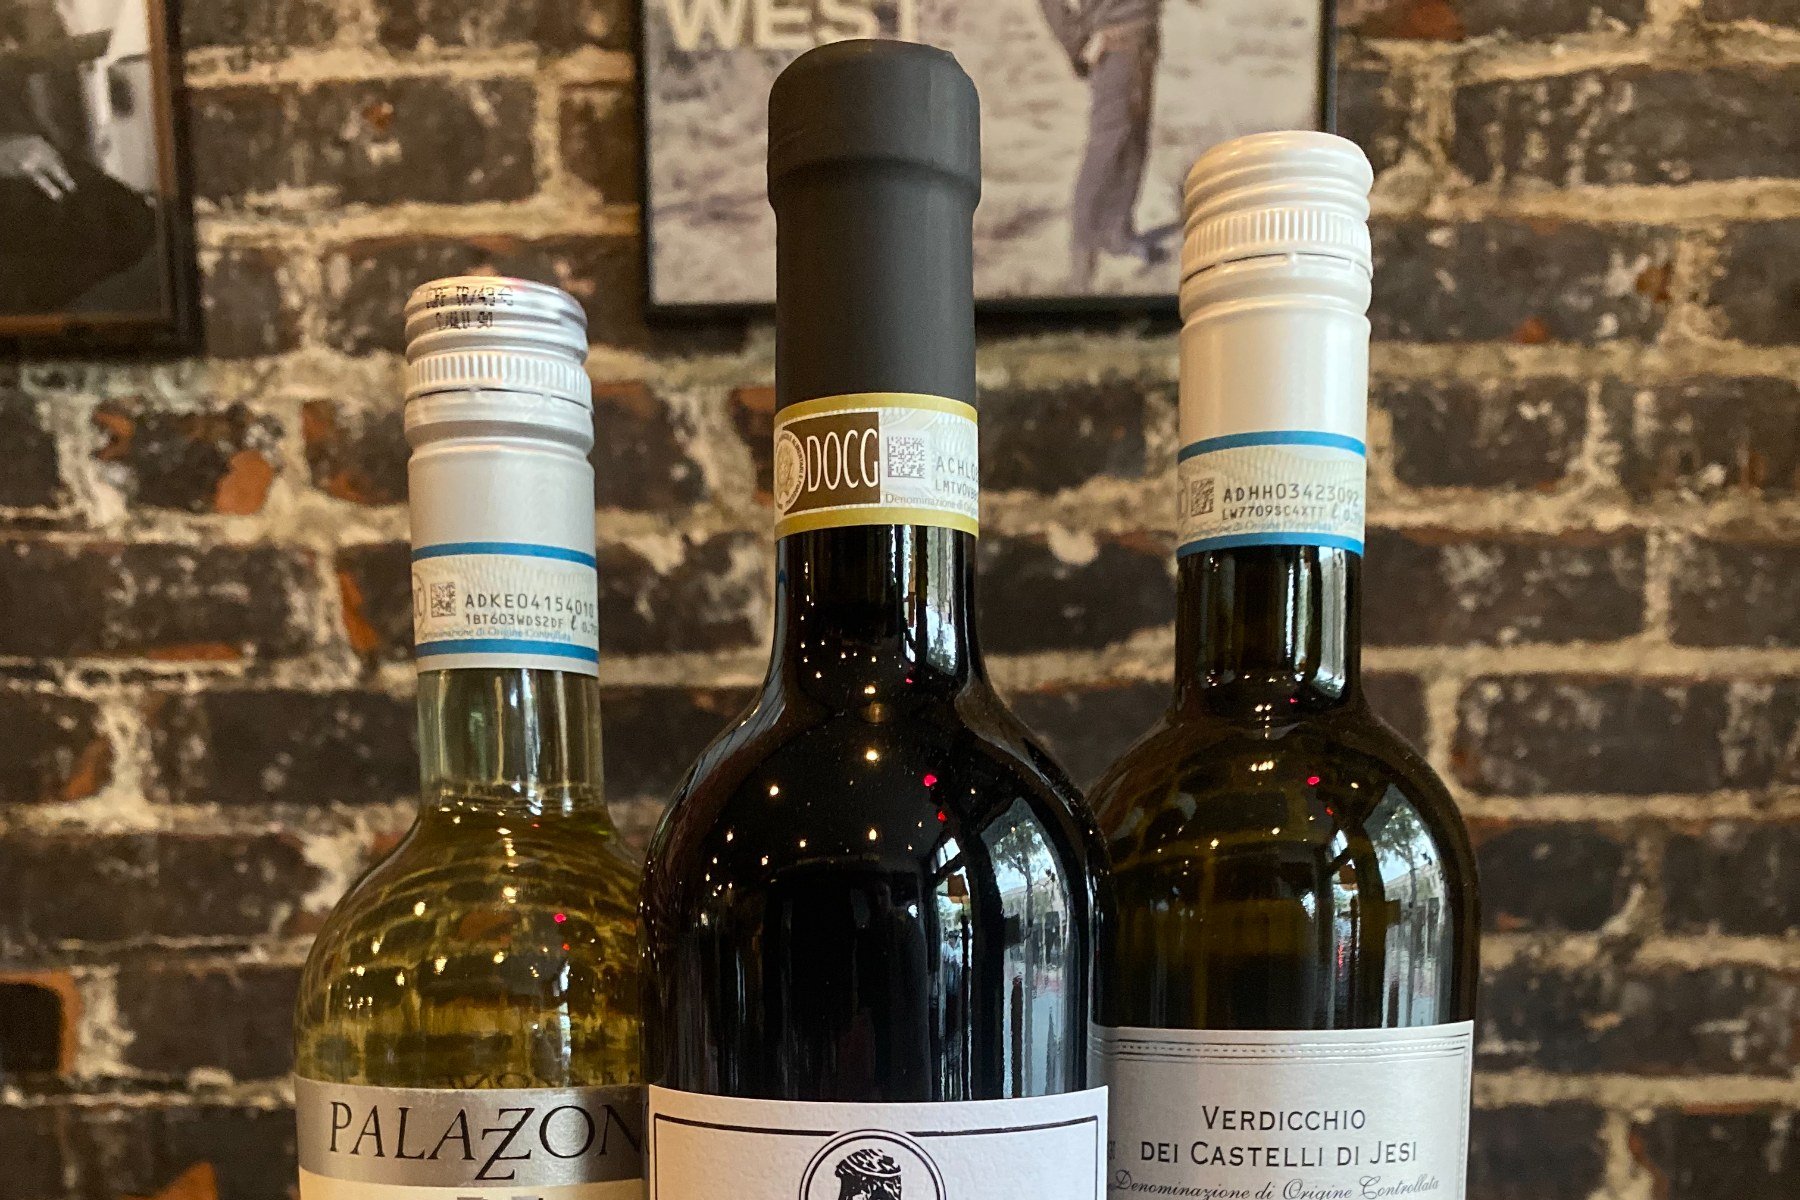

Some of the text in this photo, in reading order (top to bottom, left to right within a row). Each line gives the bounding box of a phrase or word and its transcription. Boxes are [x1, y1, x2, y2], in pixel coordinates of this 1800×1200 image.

[806, 428, 878, 492] DOCG
[1201, 1105, 1366, 1131] VERDICCHIO
[1141, 1140, 1417, 1167] DEI CASTELLI DI JESI
[1254, 1181, 1275, 1200] di
[1358, 1174, 1439, 1200] Controllata
